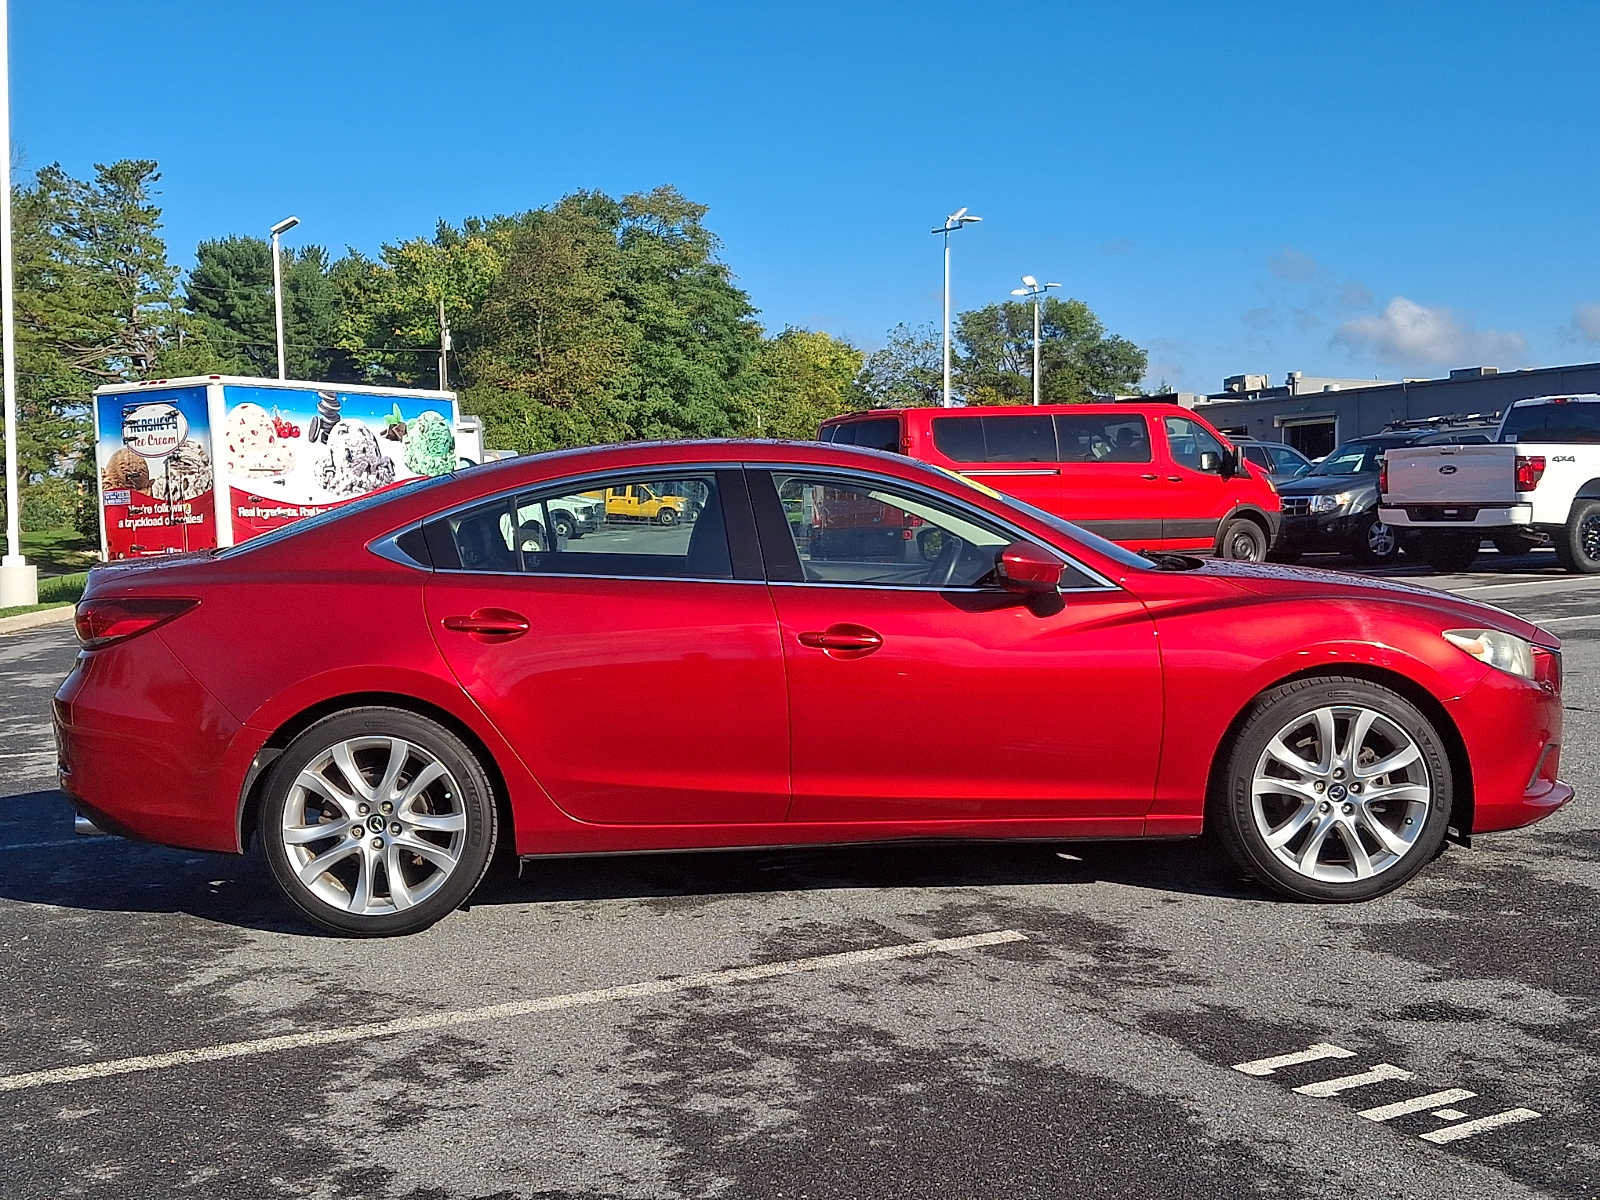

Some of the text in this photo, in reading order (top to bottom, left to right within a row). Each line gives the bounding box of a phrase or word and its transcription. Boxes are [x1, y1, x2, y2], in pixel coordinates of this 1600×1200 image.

[148, 434, 176, 446] Cream
[238, 507, 255, 517] Real
[118, 520, 124, 528] a
